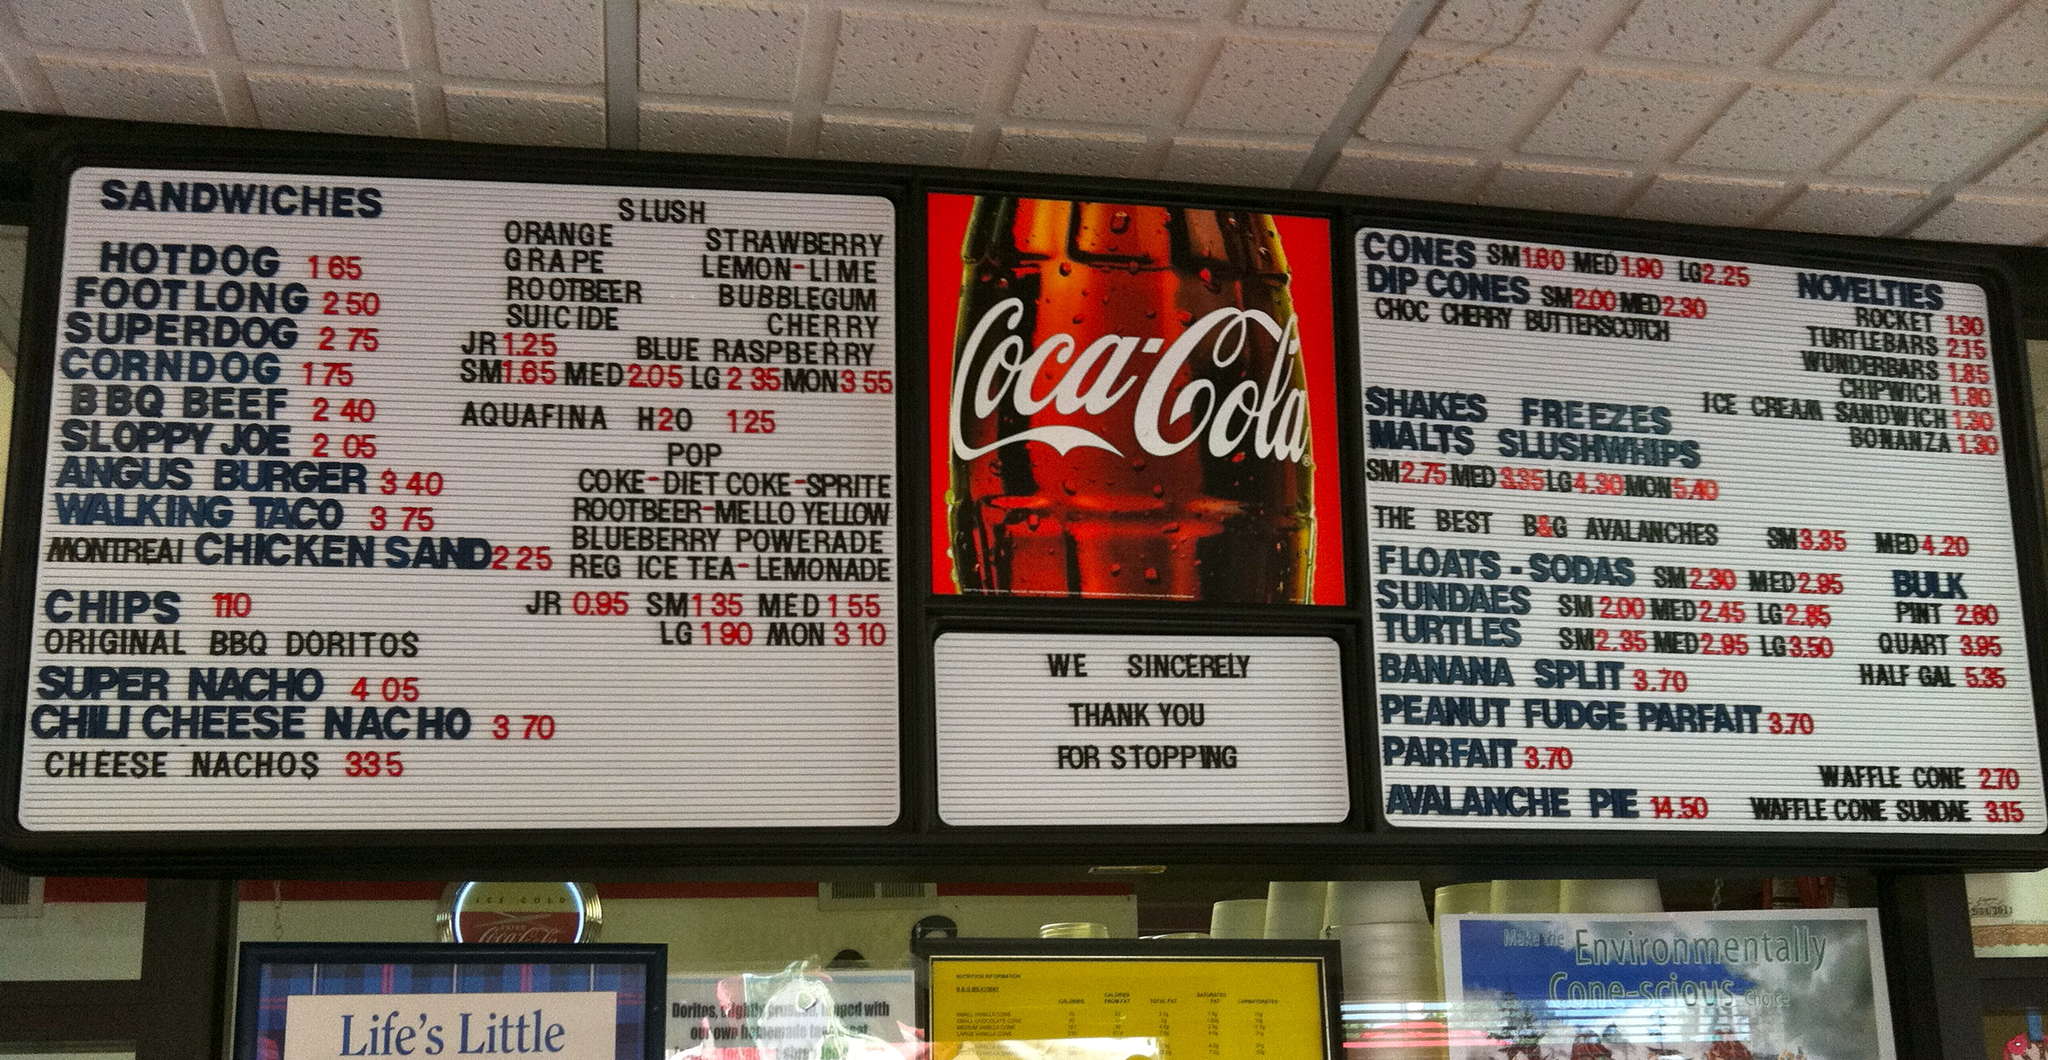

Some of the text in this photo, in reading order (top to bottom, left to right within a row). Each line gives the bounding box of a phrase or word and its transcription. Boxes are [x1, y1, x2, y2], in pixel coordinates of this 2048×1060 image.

[101, 180, 382, 217] SANDWICHES
[619, 199, 705, 224] SLUSH
[505, 221, 613, 247] ORANGE
[706, 229, 883, 257] STRAWBERRY
[101, 241, 279, 277] HOTDOG
[505, 248, 603, 273] GRAPE
[1363, 232, 1476, 268] CONES
[1574, 251, 1618, 275] MED
[507, 277, 642, 303] ROOTBEER
[719, 284, 876, 310] BUBBLEGUM
[1366, 264, 1418, 294] DIP
[1426, 268, 1530, 304] CONES
[1798, 272, 1943, 310] NOVELTIES
[64, 312, 298, 349] SUPERDOG
[507, 306, 618, 330] SUICIDE
[768, 313, 879, 338] CHERRY
[1376, 298, 1670, 342] CHOC CHERRY BUTTERSCOTCH
[1855, 307, 1933, 332] ROCKET
[461, 331, 496, 355] JR
[636, 336, 875, 366] BLUE RASPBERRY
[1807, 326, 1939, 357] TURTLEBARS
[61, 348, 281, 382] CORNDOG
[564, 362, 624, 387] MED
[691, 366, 719, 388] LG
[1801, 351, 1939, 380] WUNDERBARS
[183, 387, 288, 419] BEEF
[1840, 378, 1941, 404] CHIPWICH
[462, 402, 607, 429] AQUAFINA
[1365, 387, 1672, 435] SHAKES FREEZES
[1703, 392, 1947, 429] ICE CREAM SANDWICH
[61, 419, 290, 456] SLOPPY JOE
[1369, 420, 1700, 468] MALTS SLUSHWHIPS
[1850, 427, 1950, 453] BONANZA
[668, 443, 722, 467] POP
[56, 456, 367, 493] ANGUS BURGER
[1451, 464, 1496, 488] MED
[1548, 470, 1572, 492] LG
[55, 493, 344, 528] WALKING TACO
[802, 502, 890, 526] YELLOW
[572, 526, 883, 554] BLUEBERRY POWERADE
[1374, 506, 1415, 529] THE
[1436, 509, 1492, 534] BEST
[1586, 518, 1718, 545] AVALANCHES
[195, 532, 492, 569] CHICKEN SAND
[1875, 532, 1919, 554] MED
[570, 555, 620, 579] REG
[638, 556, 678, 579] ICE
[1378, 545, 1635, 586] FLOATS SODAS
[1653, 566, 1795, 593] SM MED
[1376, 580, 1531, 615] SUNDAES
[1892, 570, 1967, 599] BULK
[45, 590, 181, 624] CHIPS
[526, 591, 561, 615] JR
[758, 593, 819, 617] MED
[1558, 594, 1593, 617] SM
[1650, 598, 1696, 621] MED
[1757, 603, 1782, 624] LG
[1895, 602, 1942, 623] PINT
[45, 629, 419, 657] ORIGINAL BBQ DORITOS
[660, 622, 824, 646] LG MON
[1380, 613, 1521, 647] TURTLES
[1559, 627, 1595, 650] SM
[1653, 631, 1699, 654] MED
[1760, 635, 1786, 656] LG
[1879, 633, 1949, 655] QUART
[1047, 654, 1249, 678] WE SINCERELY
[1380, 653, 1686, 692] BANANA SPLIT 3.70
[1859, 664, 1956, 687] HALF GAL
[37, 666, 324, 701] SUPER NACHO
[31, 705, 471, 740] CHILI CHEESE NACHO
[1069, 703, 1204, 727] THANK YOU
[1381, 694, 1510, 727] PEANUT
[1524, 699, 1626, 730] FUDGE
[1637, 703, 1761, 733] PARFAIT
[45, 751, 319, 778] CHEESE NACHOS
[1058, 745, 1237, 769] FOR STOPPING
[1383, 736, 1517, 768] PARFAIT
[1819, 766, 1966, 789] WAFFLE CONE
[1387, 784, 1570, 817] AVALANCHE
[1590, 788, 1639, 818] PIE
[1750, 798, 1971, 822] WAFFLE CONE SUNDAE
[1575, 925, 1826, 971] Environmentally
[865, 1001, 890, 1016] with
[339, 1009, 566, 1057] Life's Little
